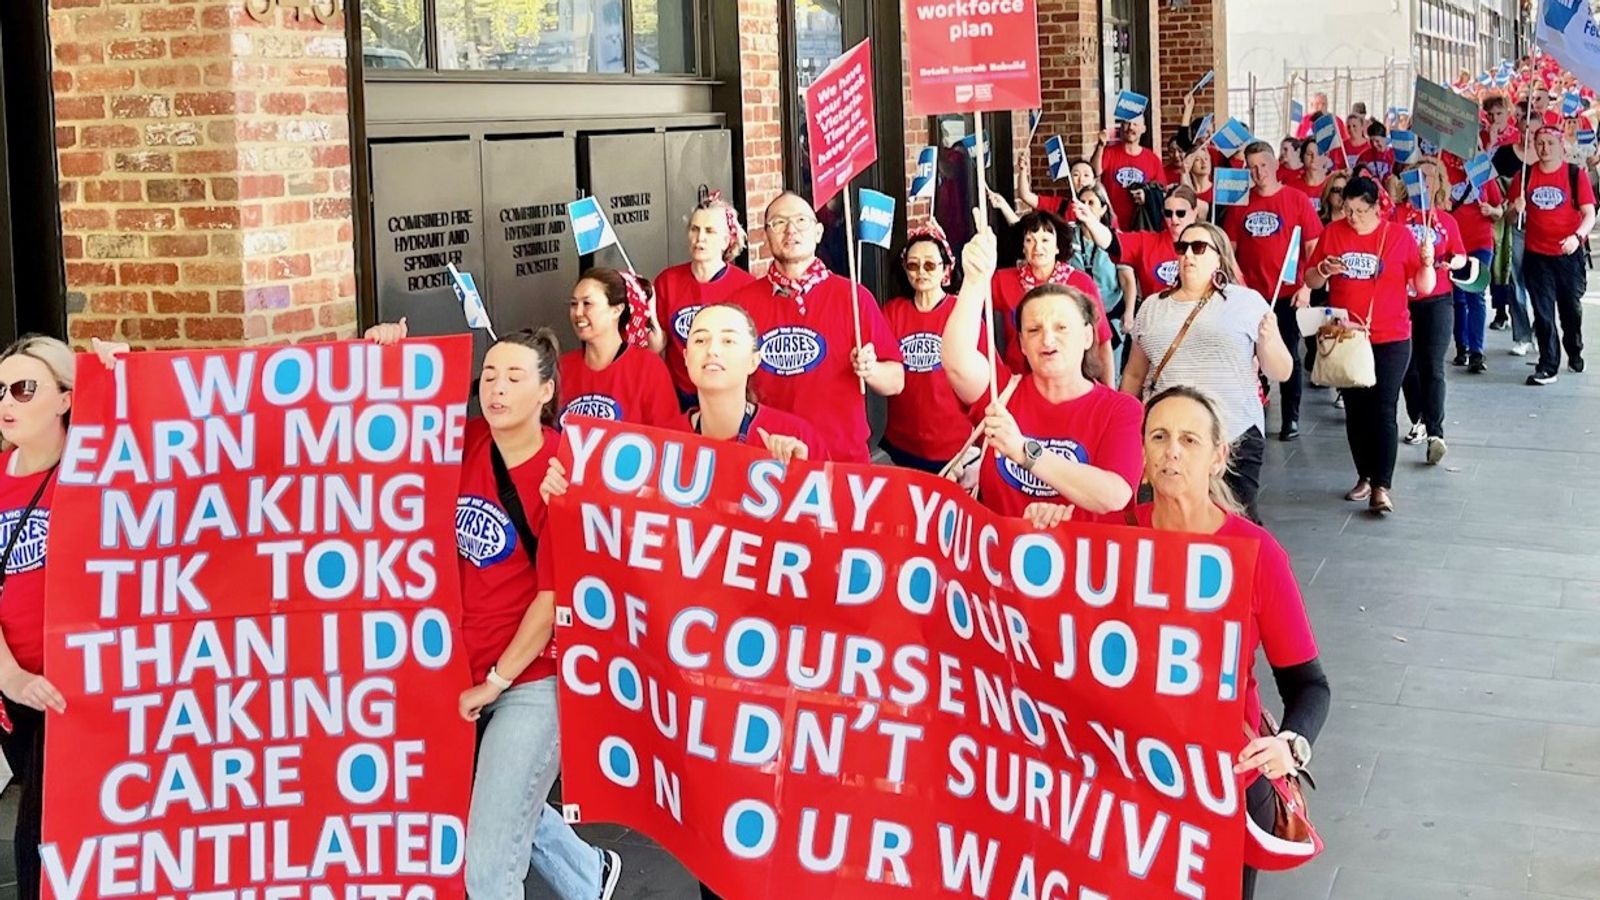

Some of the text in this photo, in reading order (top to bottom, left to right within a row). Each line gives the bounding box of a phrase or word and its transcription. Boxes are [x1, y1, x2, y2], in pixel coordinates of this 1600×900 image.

[917, 0, 1024, 20] workforce
[949, 20, 993, 42] plan
[815, 73, 865, 125] your back
[817, 62, 862, 104] We have
[824, 120, 850, 145] Time
[818, 140, 846, 167] have
[500, 204, 549, 223] COMBINED
[610, 192, 651, 209] SPRINKLER
[613, 210, 650, 226] BOOSTER
[388, 209, 474, 232] COMBINED FIRE
[505, 221, 566, 241] HYDRANT AND
[394, 229, 470, 252] HYDRANT AND
[513, 240, 560, 259] SPRINKLER
[404, 250, 462, 272] SPRINKLER
[516, 258, 559, 277] BOOSTER
[407, 271, 457, 292] BOOSTE
[765, 336, 815, 353] NURSES
[115, 343, 444, 419] I WOULD
[58, 402, 467, 484] EARN MORE
[101, 473, 426, 548] MAKING
[456, 508, 500, 543] URSES
[566, 424, 1234, 612] YOU SAY YOU COULD
[85, 537, 437, 617] TIK TOKS
[580, 502, 1242, 700] NEVER DO OUR JOB!
[65, 608, 453, 694] THAN I DO
[572, 575, 1238, 816] OF COURSE NOT, YOU
[112, 673, 397, 755] TAKING
[100, 739, 425, 825] CARE OF
[561, 644, 1211, 900] COULDN'T SURVIVE
[598, 735, 683, 825] ON
[722, 798, 912, 888] OUR
[38, 812, 466, 900] VENTILATED
